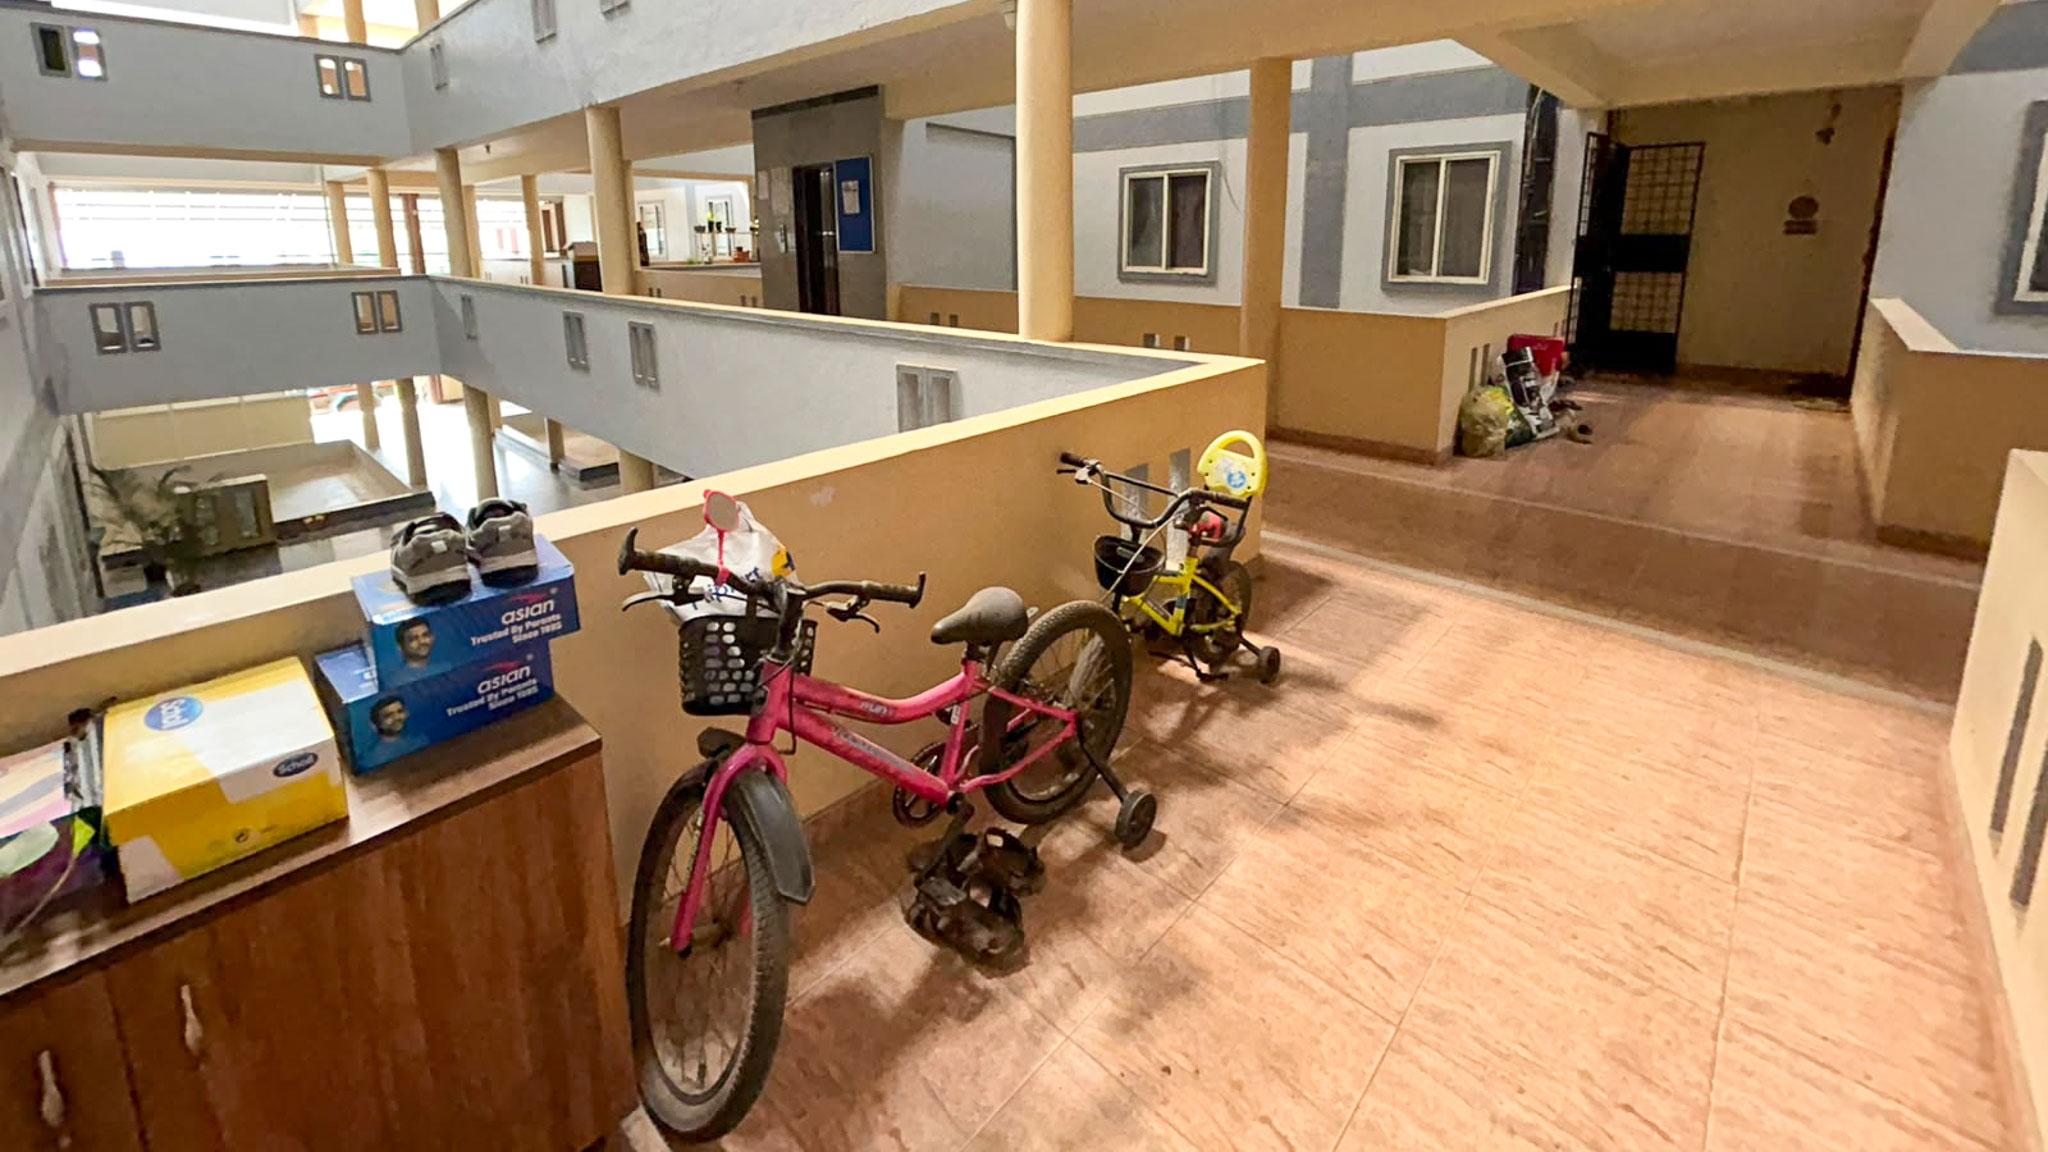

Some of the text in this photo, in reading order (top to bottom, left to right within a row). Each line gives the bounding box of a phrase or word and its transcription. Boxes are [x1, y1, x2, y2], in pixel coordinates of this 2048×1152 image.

[501, 599, 555, 625] asian
[470, 613, 562, 646] Trusted By Parents
[512, 630, 539, 643] Since
[477, 665, 531, 694] asian
[445, 695, 486, 717] Trusted
[501, 678, 538, 697] Parents
